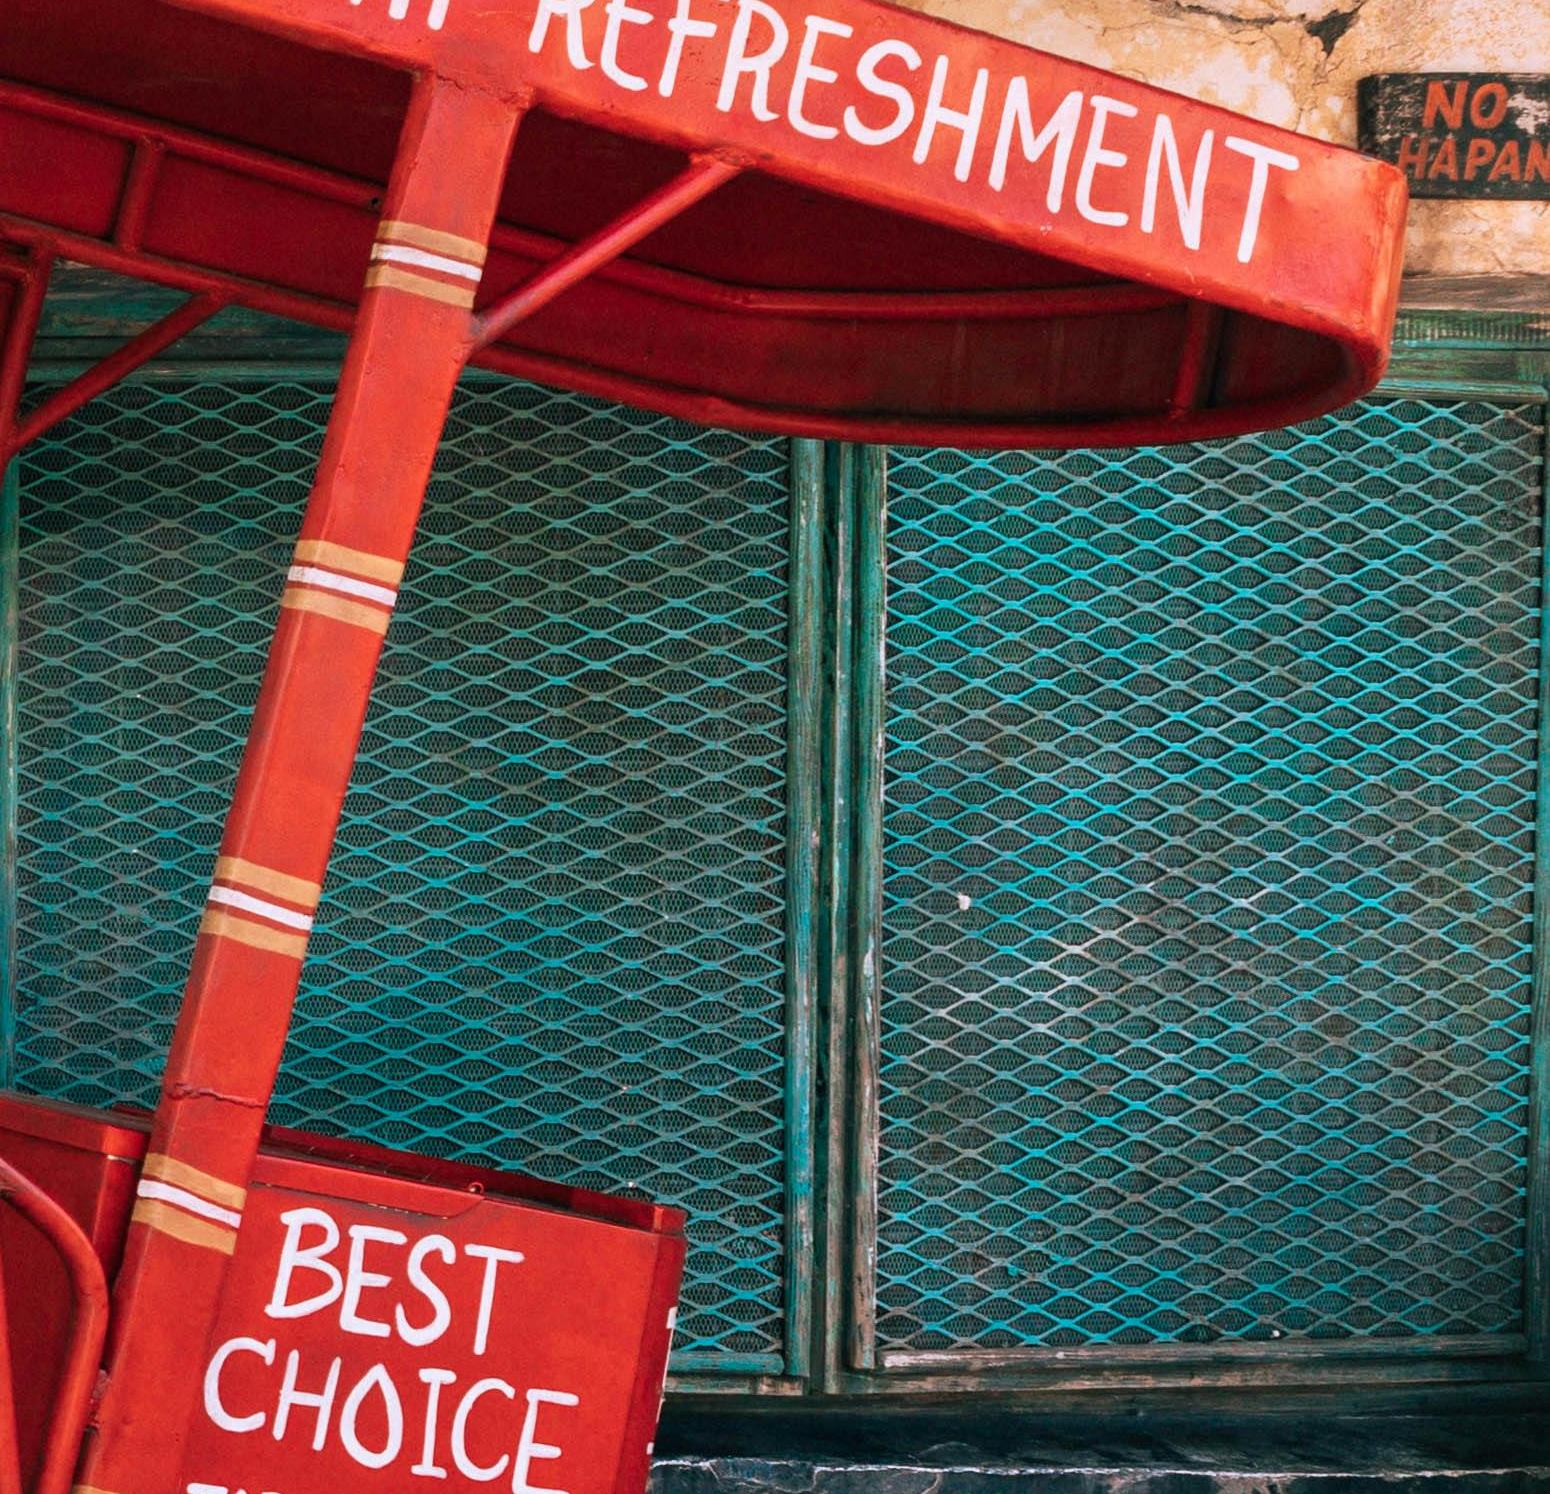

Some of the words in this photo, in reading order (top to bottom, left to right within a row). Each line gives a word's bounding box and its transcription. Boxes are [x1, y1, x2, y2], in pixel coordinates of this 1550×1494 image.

[1420, 79, 1509, 130] NO
[1397, 135, 1550, 182] HAPAN
[263, 1207, 525, 1356] BEST
